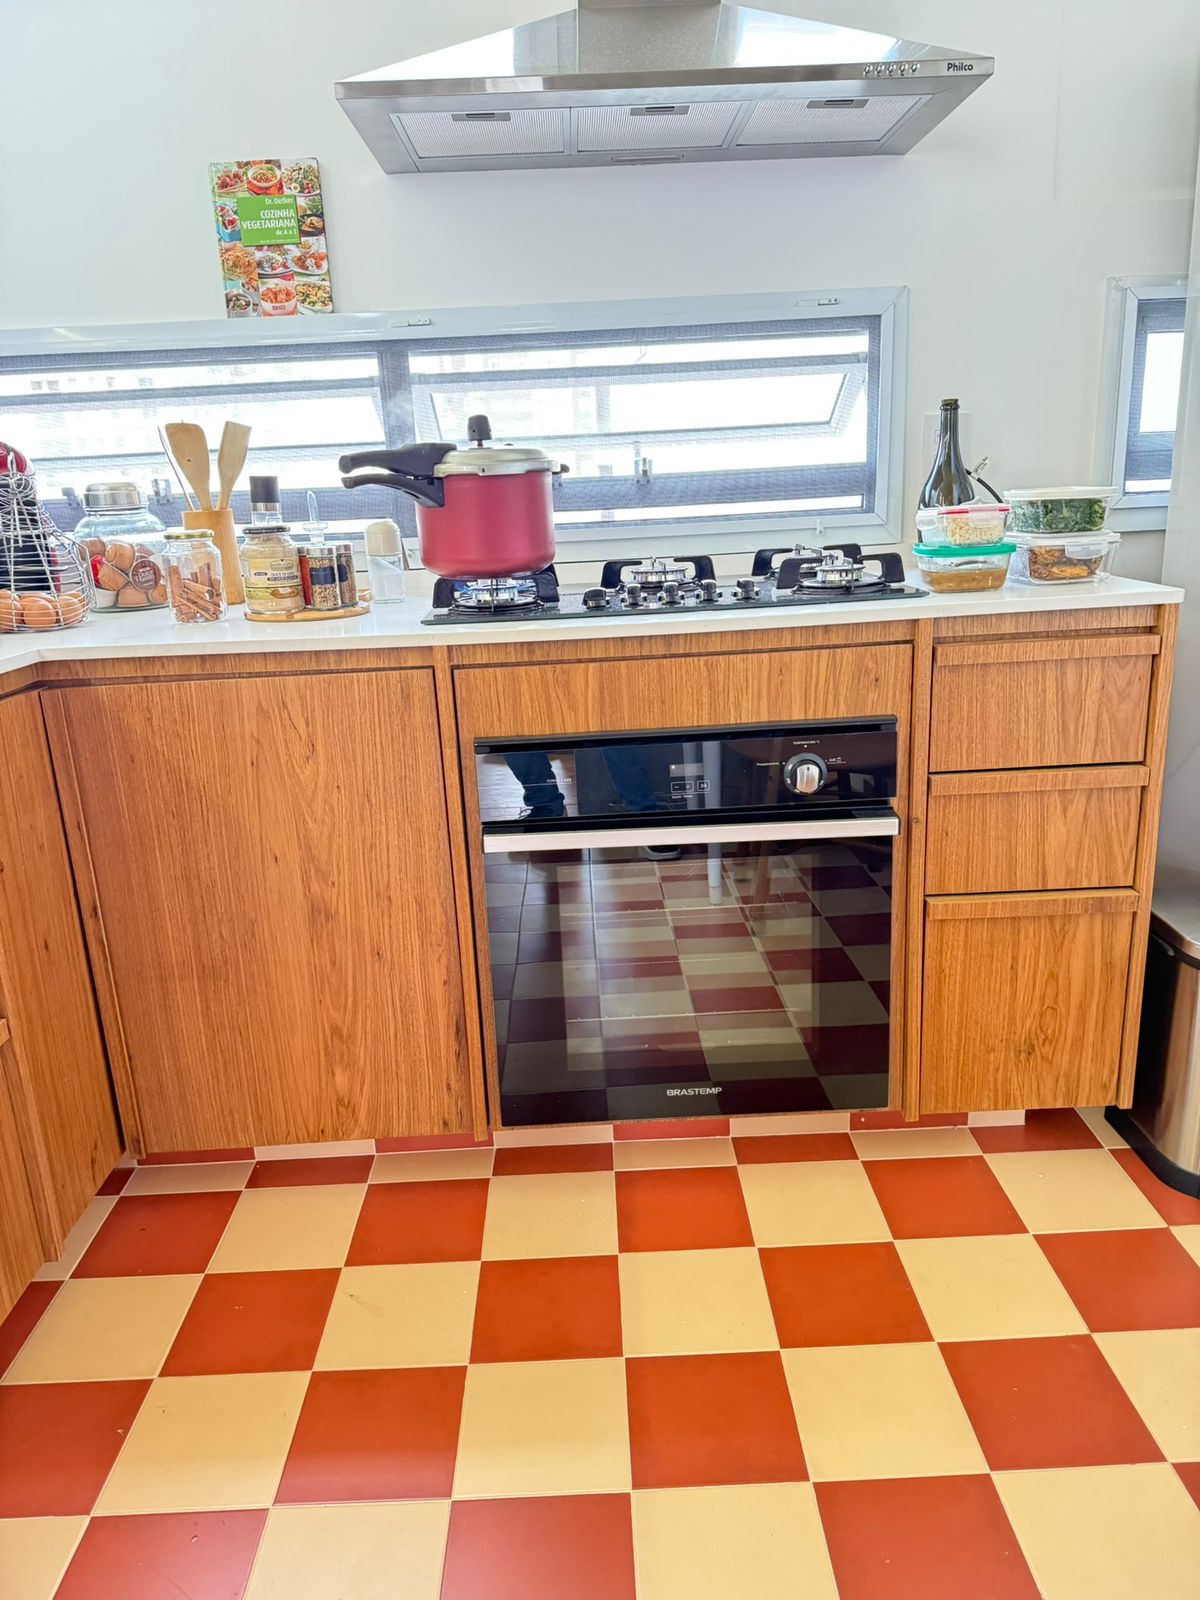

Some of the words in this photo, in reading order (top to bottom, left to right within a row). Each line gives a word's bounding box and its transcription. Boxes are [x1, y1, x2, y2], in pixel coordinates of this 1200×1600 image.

[947, 62, 973, 72] Philco
[260, 209, 295, 218] COZINHA
[241, 219, 297, 229] VEGETARIANA
[666, 1087, 723, 1096] BRASTEMP
